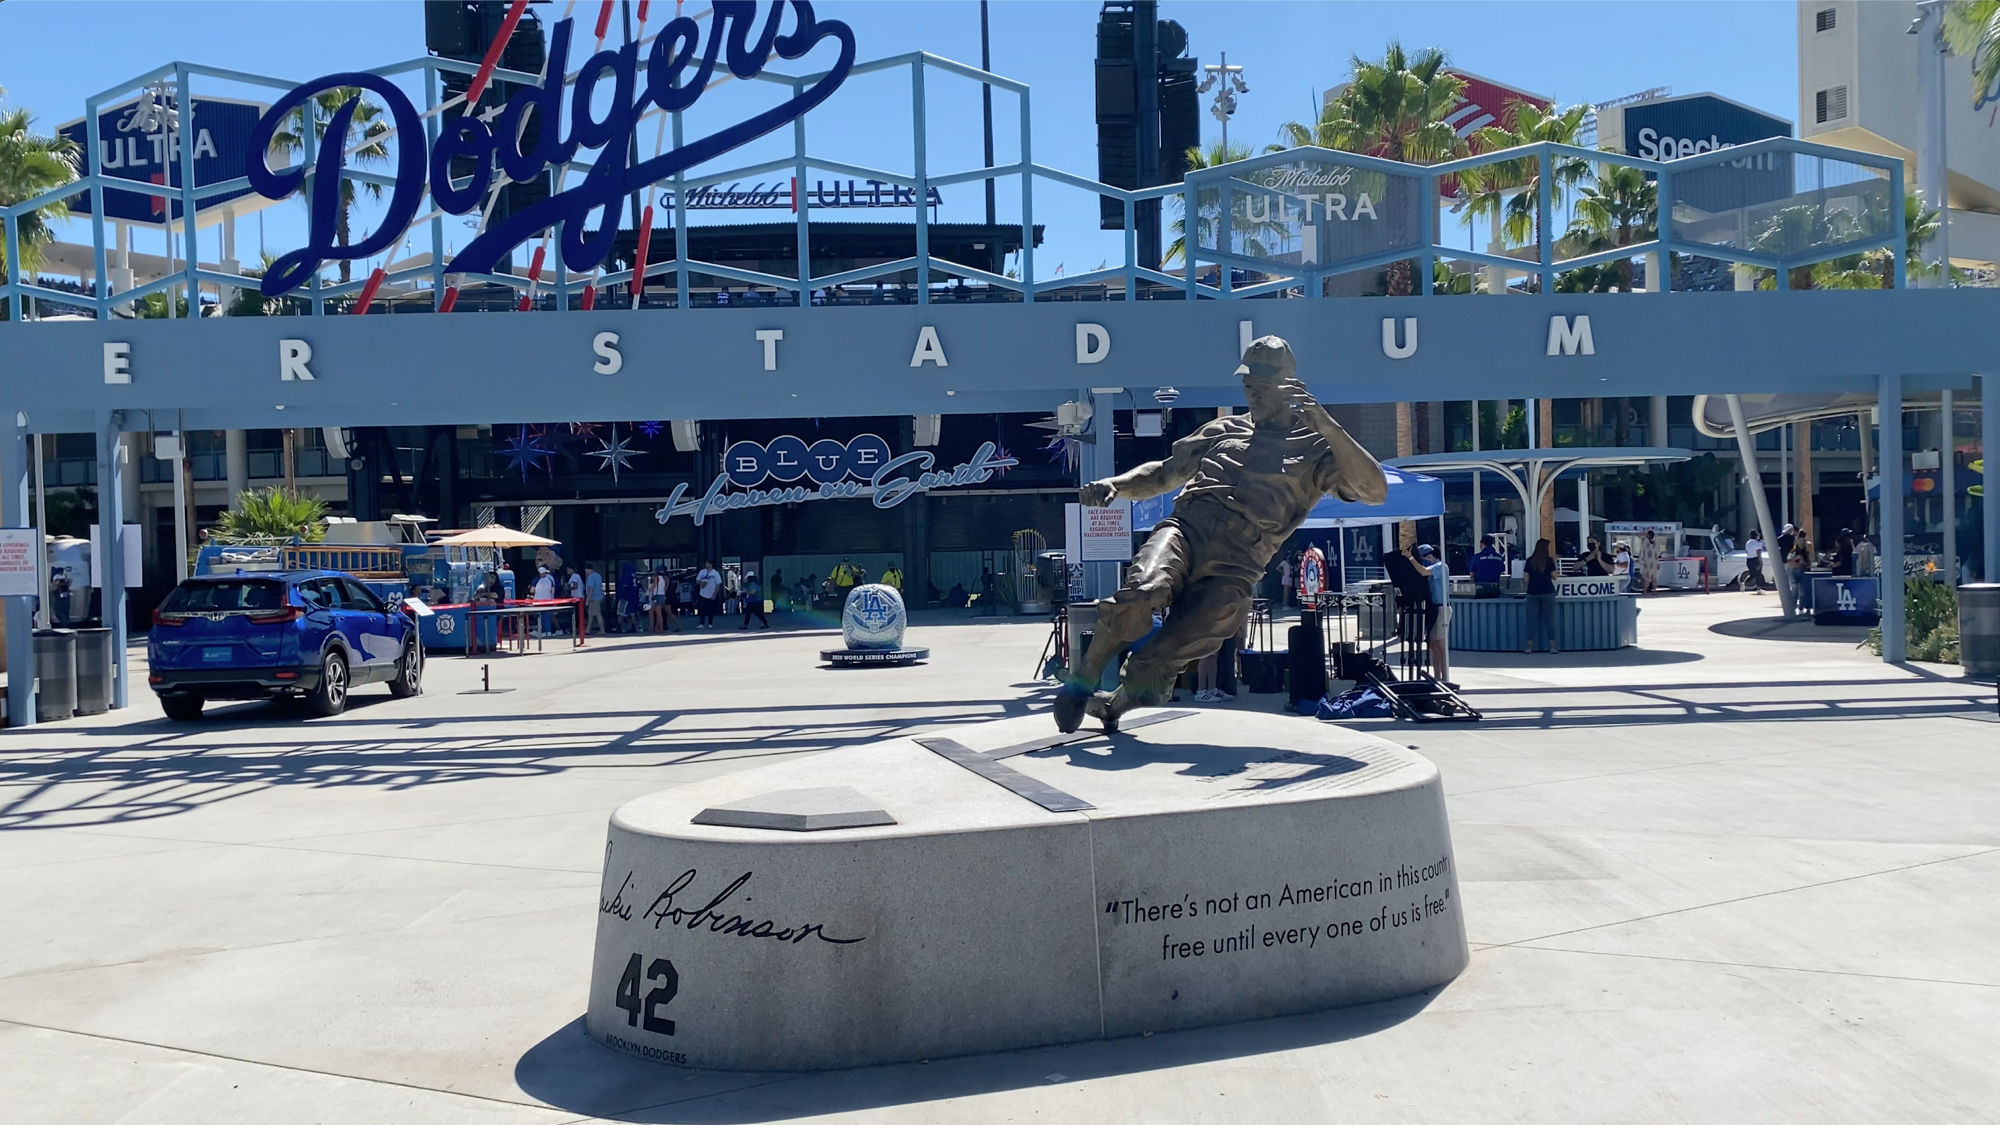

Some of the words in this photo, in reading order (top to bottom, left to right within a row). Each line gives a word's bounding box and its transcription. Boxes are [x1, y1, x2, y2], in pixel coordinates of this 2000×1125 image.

[100, 128, 218, 169] ULTRA
[245, 0, 856, 297] Dodgers
[1263, 165, 1353, 190] Michelob
[660, 182, 785, 209] Michelob
[817, 180, 944, 207] ULTRA
[1246, 192, 1378, 222] ULTRA
[735, 448, 879, 474] BLUE
[654, 472, 811, 527] Heaven
[819, 480, 864, 500] on
[871, 440, 1020, 509] Earth
[1326, 540, 1338, 568] LA
[1350, 528, 1374, 562] LA
[1678, 562, 1690, 580] LA
[861, 589, 887, 621] LA
[1836, 582, 1857, 611] LA
[1205, 892, 1239, 915] not
[1245, 893, 1271, 911] an
[1278, 879, 1373, 907] American
[1379, 873, 1393, 893] in
[1397, 863, 1420, 889] this
[1421, 854, 1451, 882] country
[643, 868, 866, 944] Robinson
[1163, 934, 1205, 961] free
[1213, 924, 1255, 954] until
[1262, 925, 1320, 949] every
[1326, 919, 1364, 939] one
[1369, 906, 1388, 932] of
[1391, 910, 1408, 928] us
[1411, 902, 1421, 923] is
[615, 952, 680, 1037] 42
[642, 1046, 687, 1065] DODGERS
